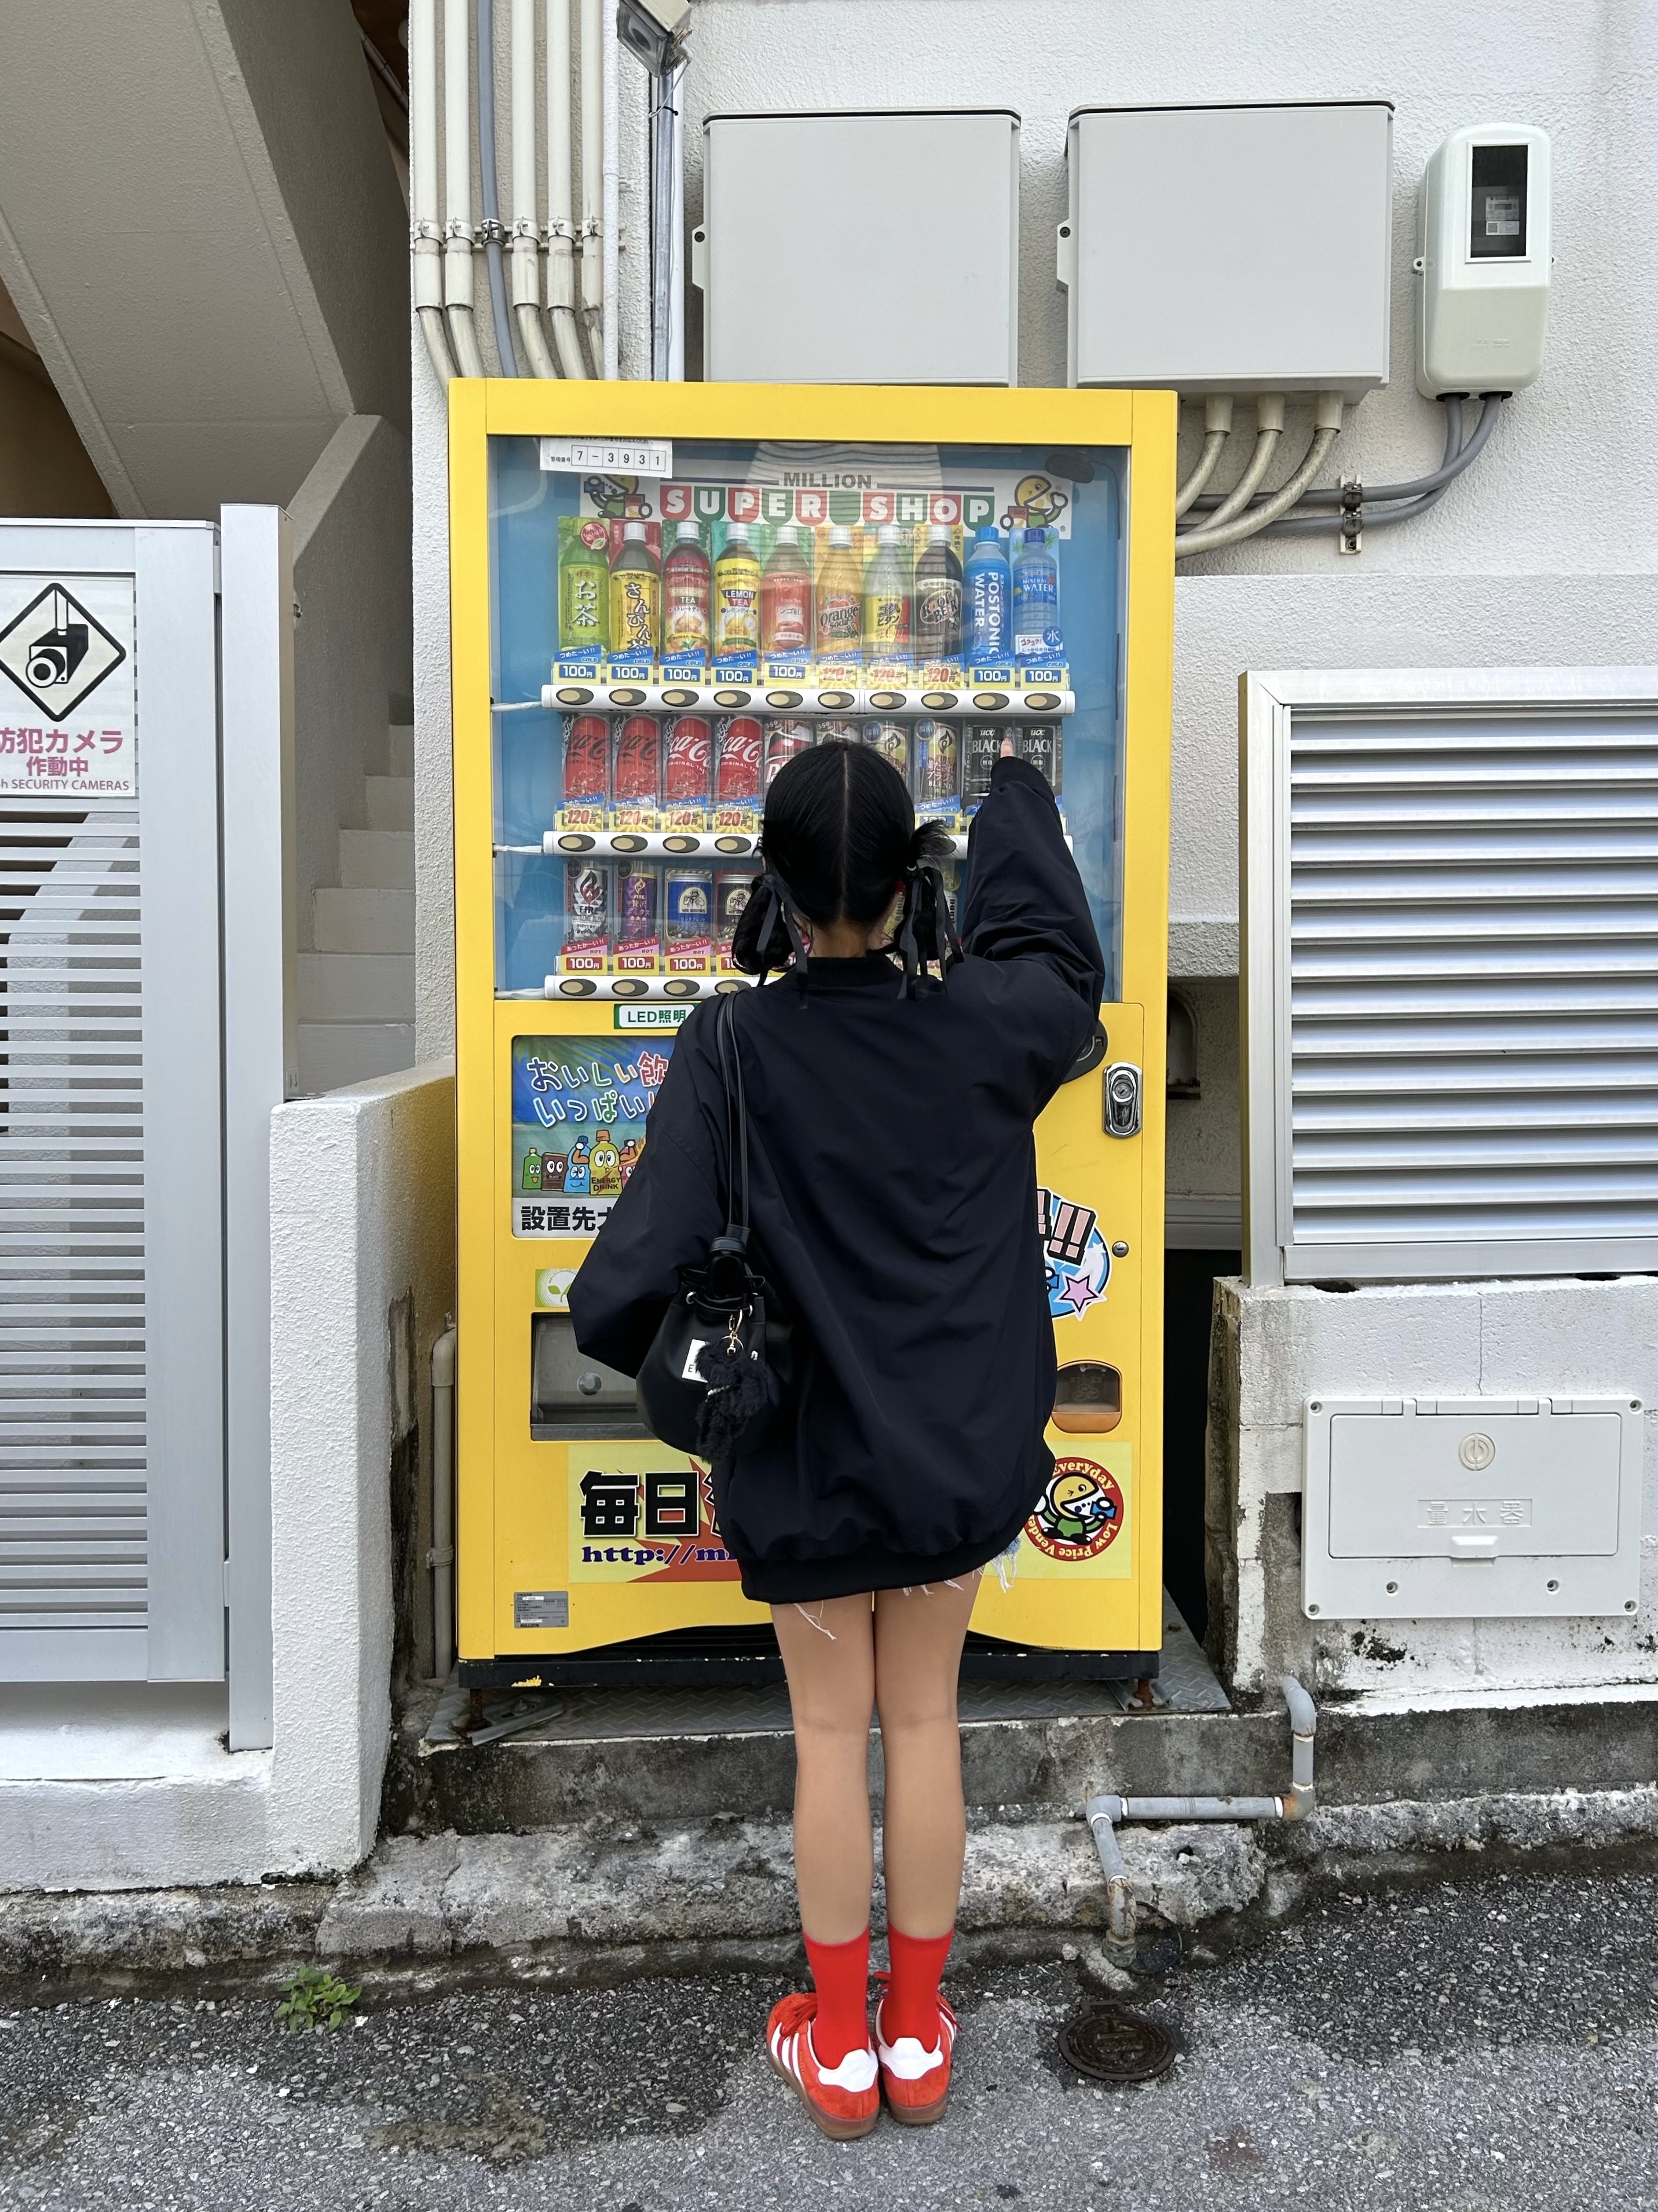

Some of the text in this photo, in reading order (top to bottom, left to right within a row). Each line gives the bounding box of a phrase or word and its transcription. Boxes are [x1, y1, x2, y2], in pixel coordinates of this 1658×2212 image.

[784, 472, 872, 489] MILLION
[666, 489, 990, 522] SUPER SHOP
[726, 590, 754, 599] LEMON
[1023, 583, 1054, 593] WATER
[572, 580, 601, 626] お茶
[975, 572, 985, 627] WATER
[820, 606, 859, 626] Orange
[829, 619, 848, 630] soda
[1046, 630, 1059, 643] 水
[563, 666, 593, 678] 100円
[616, 667, 645, 679] 100円
[668, 669, 697, 681] 100円
[720, 670, 749, 682] 100円
[773, 666, 802, 678] 100円
[927, 668, 956, 682] 120円
[978, 670, 1007, 682] 100円
[1030, 671, 1059, 682] 100円
[0, 727, 124, 754] 防犯カメラ
[1023, 739, 1052, 754] BLACK
[26, 756, 89, 777] 作動中
[11, 779, 68, 790] SECURITY
[71, 780, 130, 791] CAMERAS
[928, 780, 953, 790] BLEND
[567, 809, 597, 825] 120円
[619, 810, 649, 825] 120円
[719, 811, 748, 827] 120円
[579, 906, 598, 915] FIRE
[627, 908, 650, 916] デミタス
[569, 958, 599, 969] 100円
[622, 957, 651, 968] 100円
[674, 959, 703, 970] 100円
[628, 1010, 686, 1023] LED照明
[533, 1089, 654, 1128] いっぱい
[1052, 1461, 1115, 1490] Everyday
[579, 1470, 722, 1537] 毎日
[1426, 1501, 1524, 1526] 量水器
[1095, 1522, 1118, 1549] Low
[1059, 1545, 1094, 1559] Price
